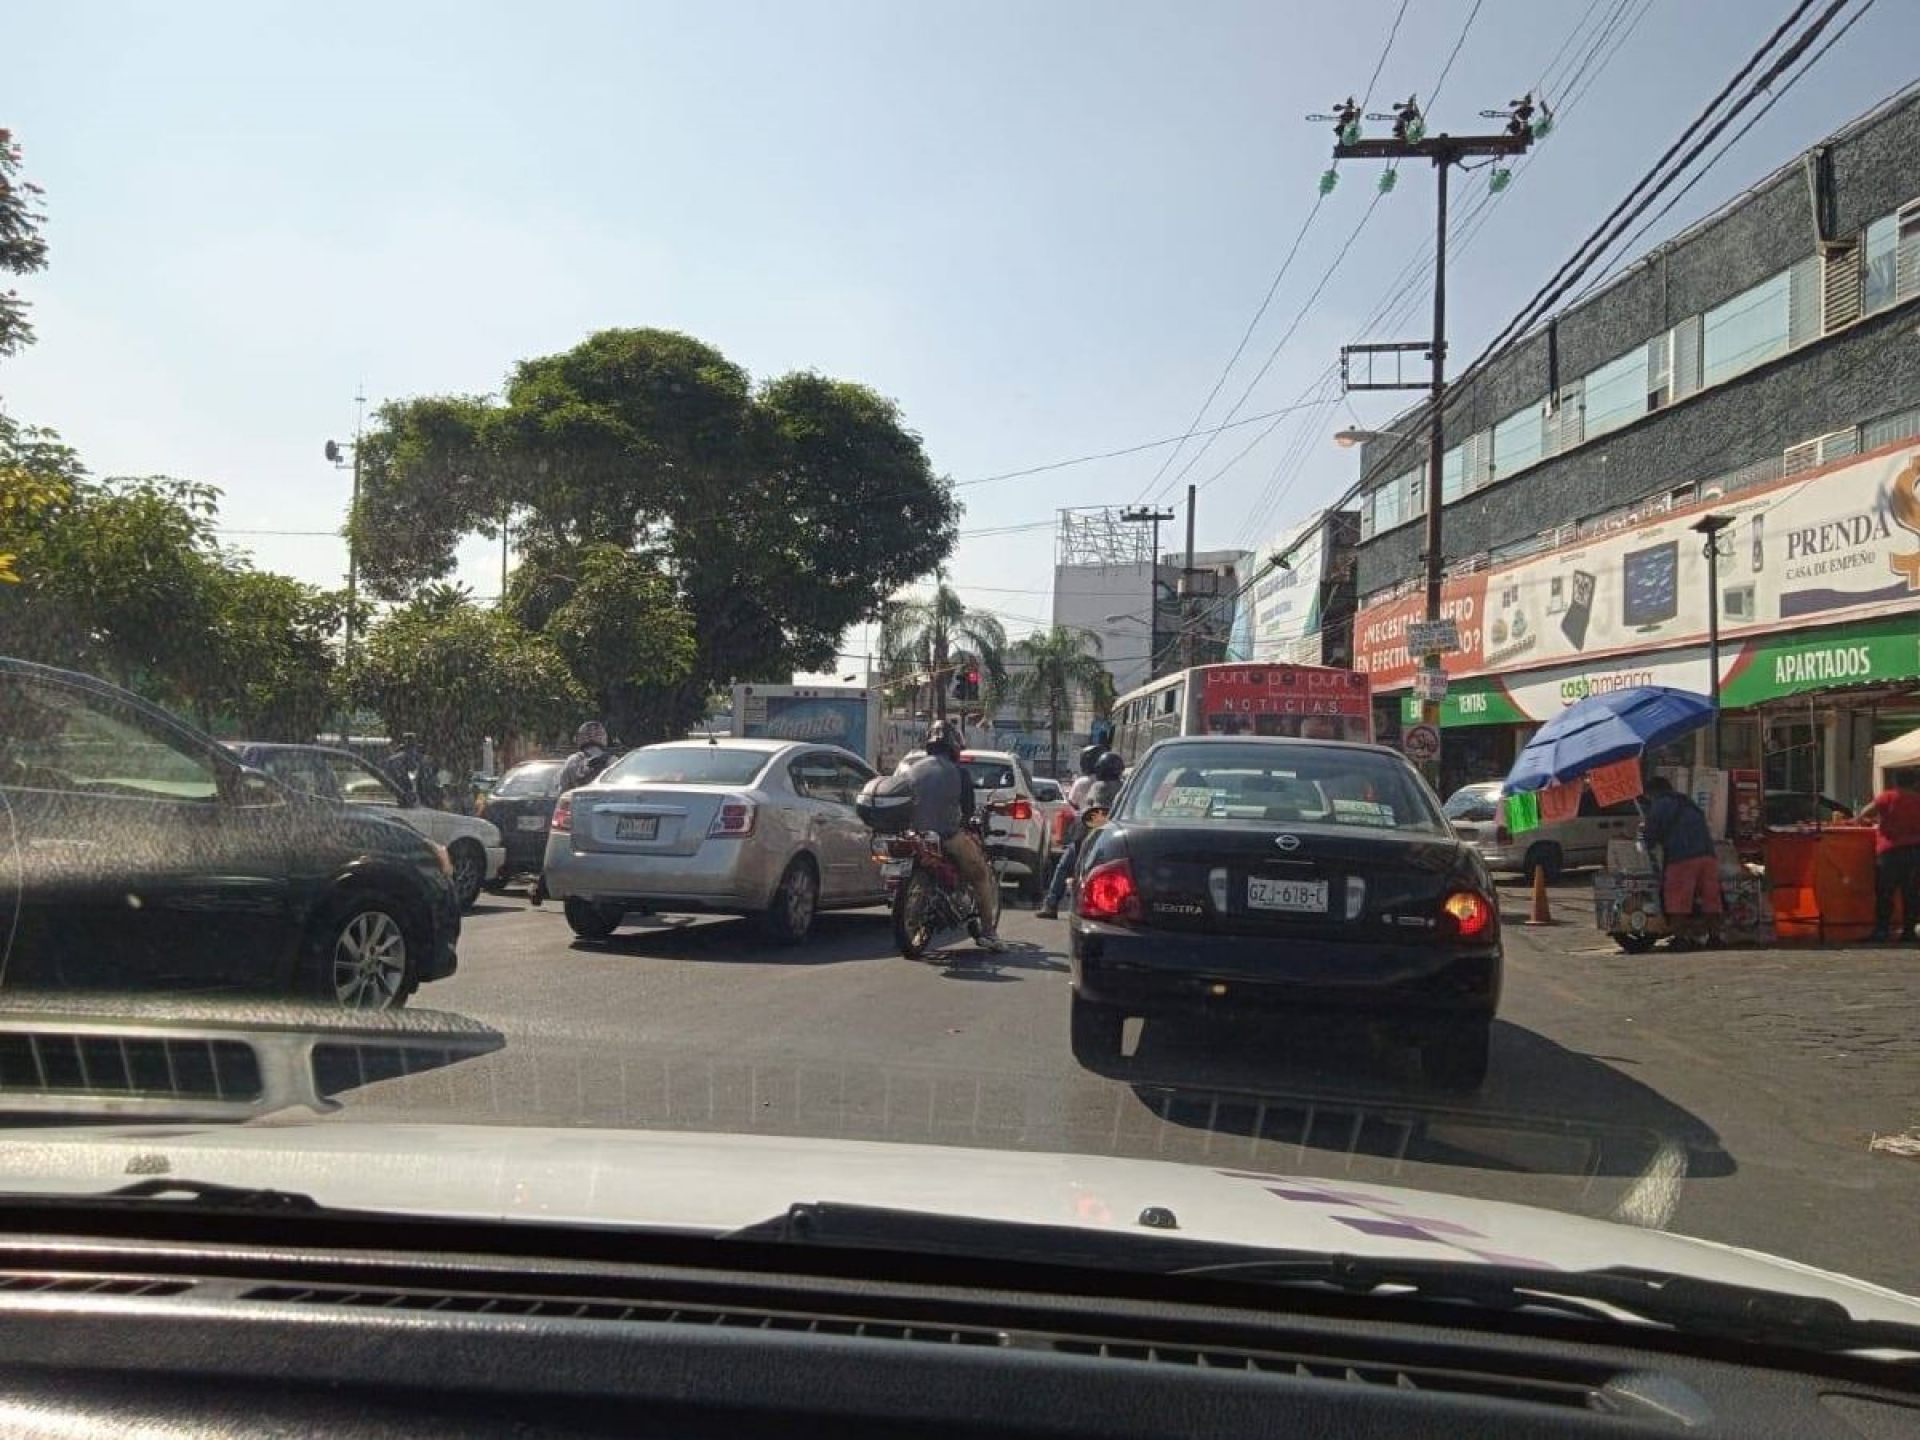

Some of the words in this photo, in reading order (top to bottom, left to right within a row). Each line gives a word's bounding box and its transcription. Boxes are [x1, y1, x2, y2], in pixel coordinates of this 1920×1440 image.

[1787, 508, 1891, 560] PRENDA
[1787, 564, 1812, 579] CASA
[1814, 562, 1827, 576] DE
[1829, 550, 1876, 572] EMPEÑO
[1775, 646, 1871, 684] APARTADOS
[1224, 698, 1340, 714] NOTICIAS
